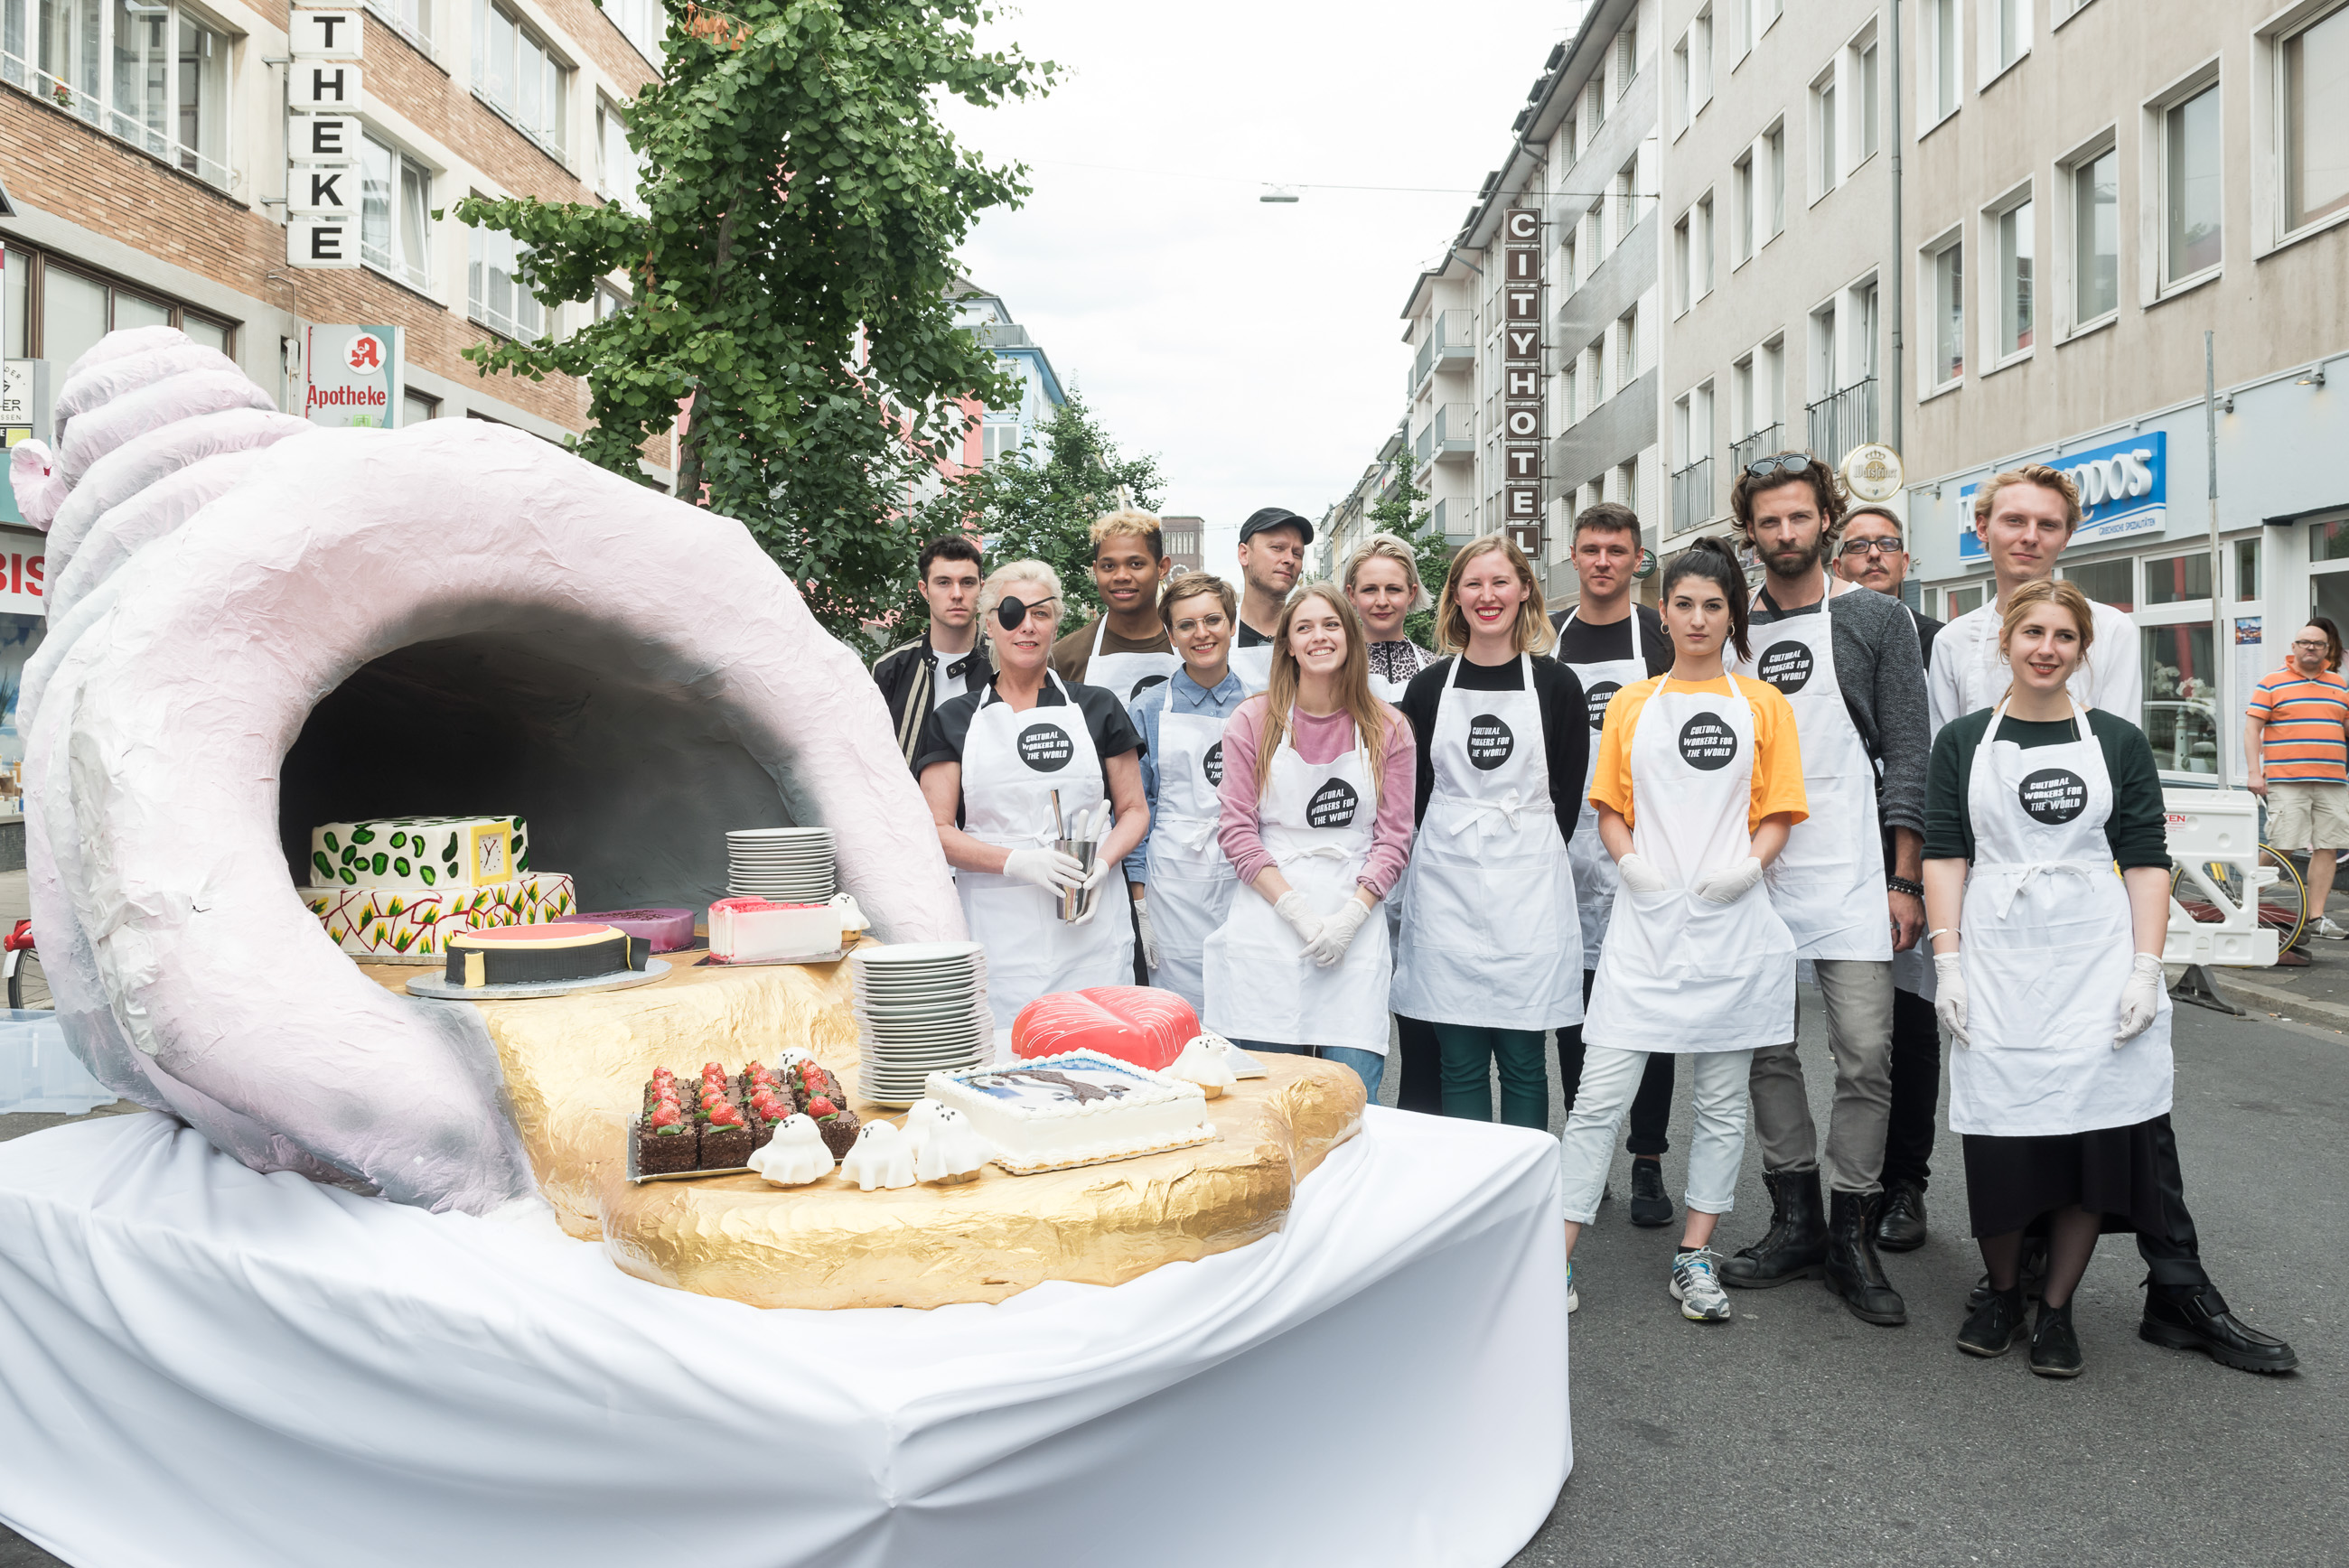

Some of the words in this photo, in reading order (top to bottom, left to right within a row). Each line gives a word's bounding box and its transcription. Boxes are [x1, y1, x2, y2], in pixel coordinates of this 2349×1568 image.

[307, 385, 386, 409] Apotheke
[1853, 462, 1897, 481] Warsteiner
[2064, 449, 2153, 509] ODOS
[1769, 649, 1802, 663] CULTURAL
[1763, 661, 1796, 674] WORKERS
[1797, 659, 1811, 669] FOR
[1765, 674, 1780, 683] THE
[1781, 671, 1807, 681] WORLD
[1589, 713, 1601, 721] THE
[1472, 726, 1501, 735] CULTURAL
[1689, 724, 1723, 735] CULTURAL
[1025, 731, 1059, 743] CULTURAL
[1496, 736, 1510, 746] FOR
[1683, 736, 1718, 747] WORKERS
[1719, 736, 1734, 745] FOR
[1022, 741, 1054, 751] WORKERS
[1056, 740, 1070, 748] FOR
[1026, 751, 1040, 761] THE
[1043, 750, 1068, 760] WORLD
[1483, 748, 1507, 758] WORLD
[1687, 749, 1701, 758] THE
[1703, 747, 1731, 757] WORLD
[2030, 777, 2070, 790] CULTURAL
[1316, 788, 1345, 803] CULTURAL
[2024, 788, 2064, 800] WORKERS
[2066, 786, 2082, 796] FOR
[1311, 800, 1341, 817] WORKERS
[1343, 798, 1355, 808] FOR
[2031, 801, 2046, 812] THE
[2049, 798, 2081, 810] WORLD
[1314, 815, 1327, 826] THE
[1329, 809, 1354, 823] WORLD
